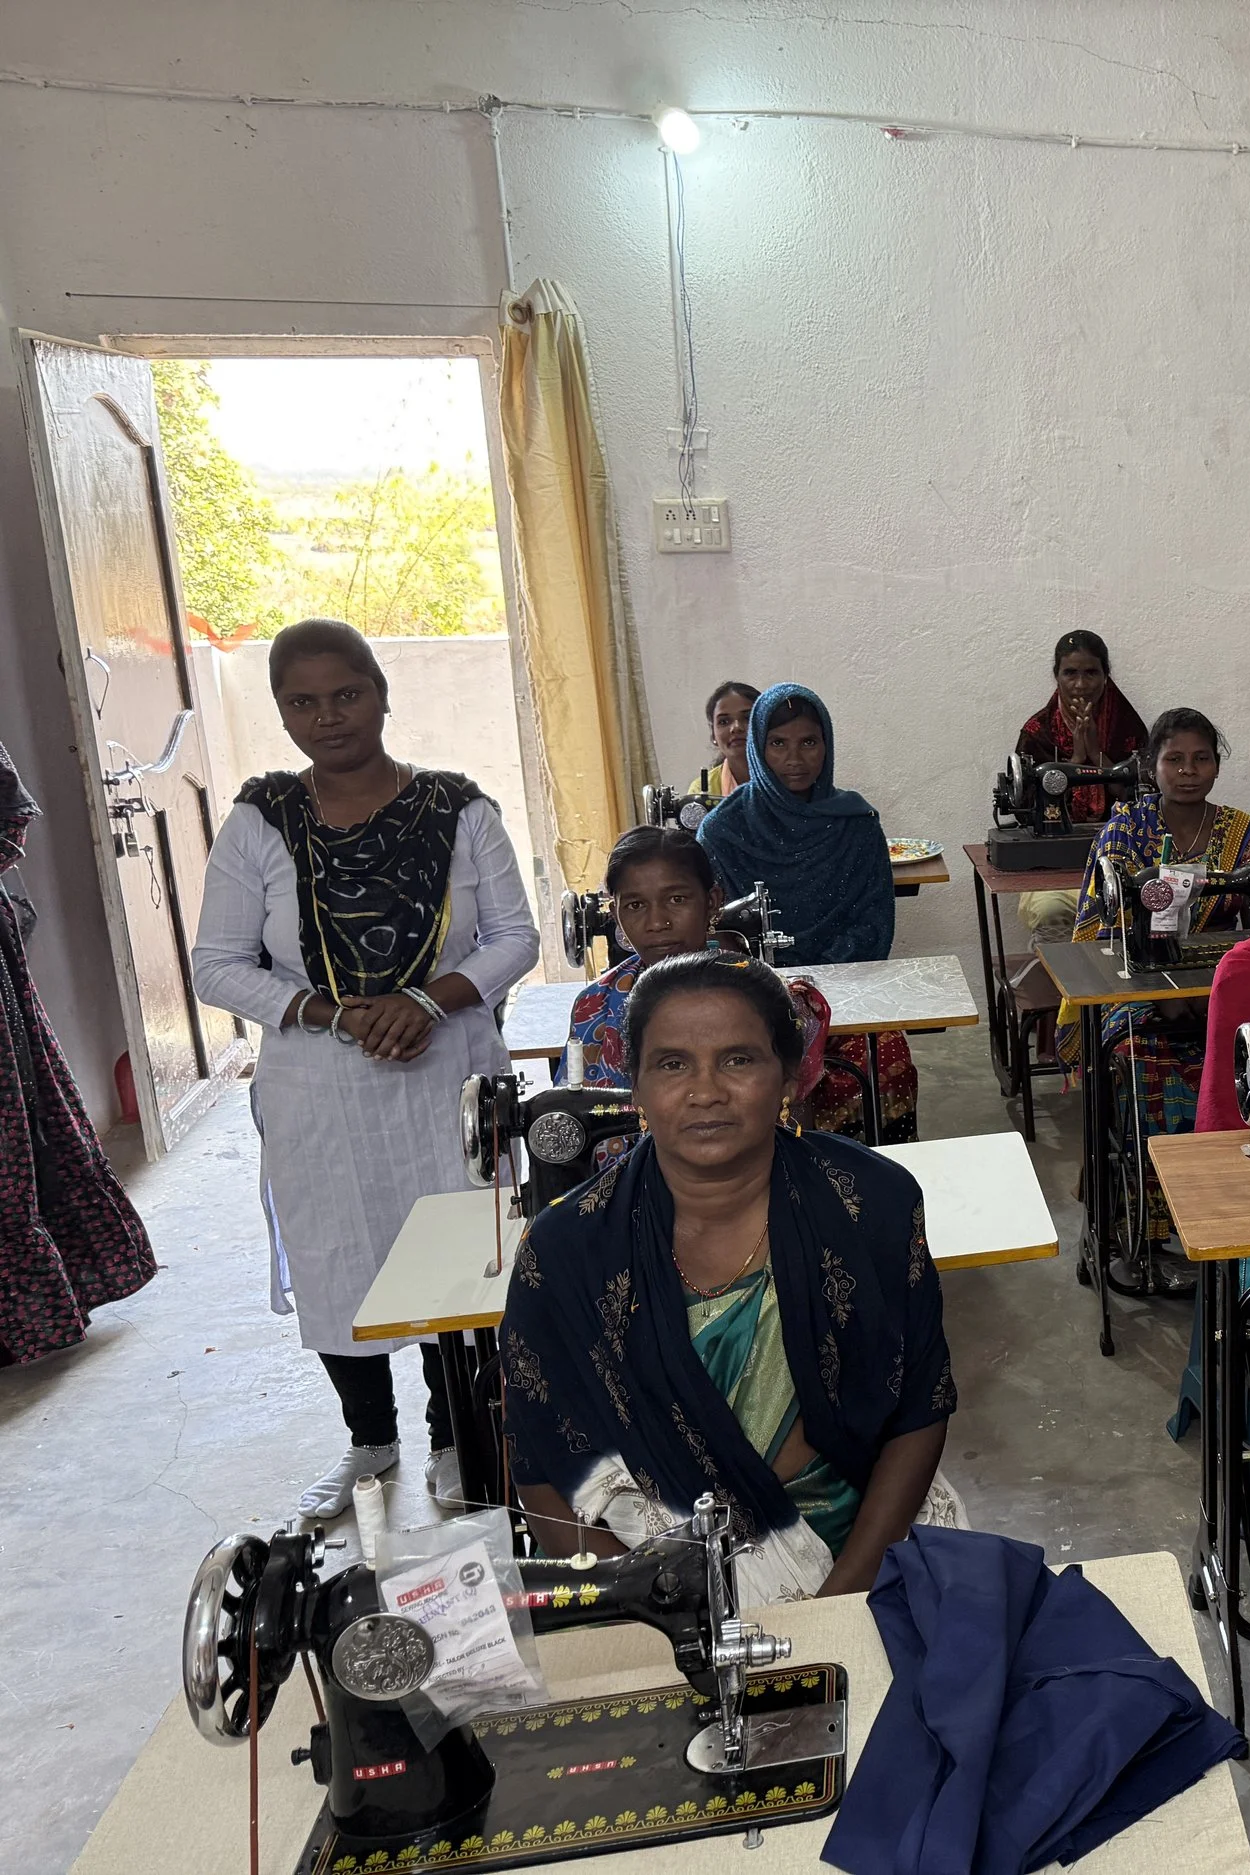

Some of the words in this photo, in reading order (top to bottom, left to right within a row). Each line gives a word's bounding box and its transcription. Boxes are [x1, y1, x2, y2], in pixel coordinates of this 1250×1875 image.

[397, 1577, 445, 1606] USHA
[503, 1593, 548, 1607] SHA
[487, 1637, 507, 1651] BLACK
[355, 1760, 405, 1780] USHA
[567, 1760, 616, 1775] USHA
